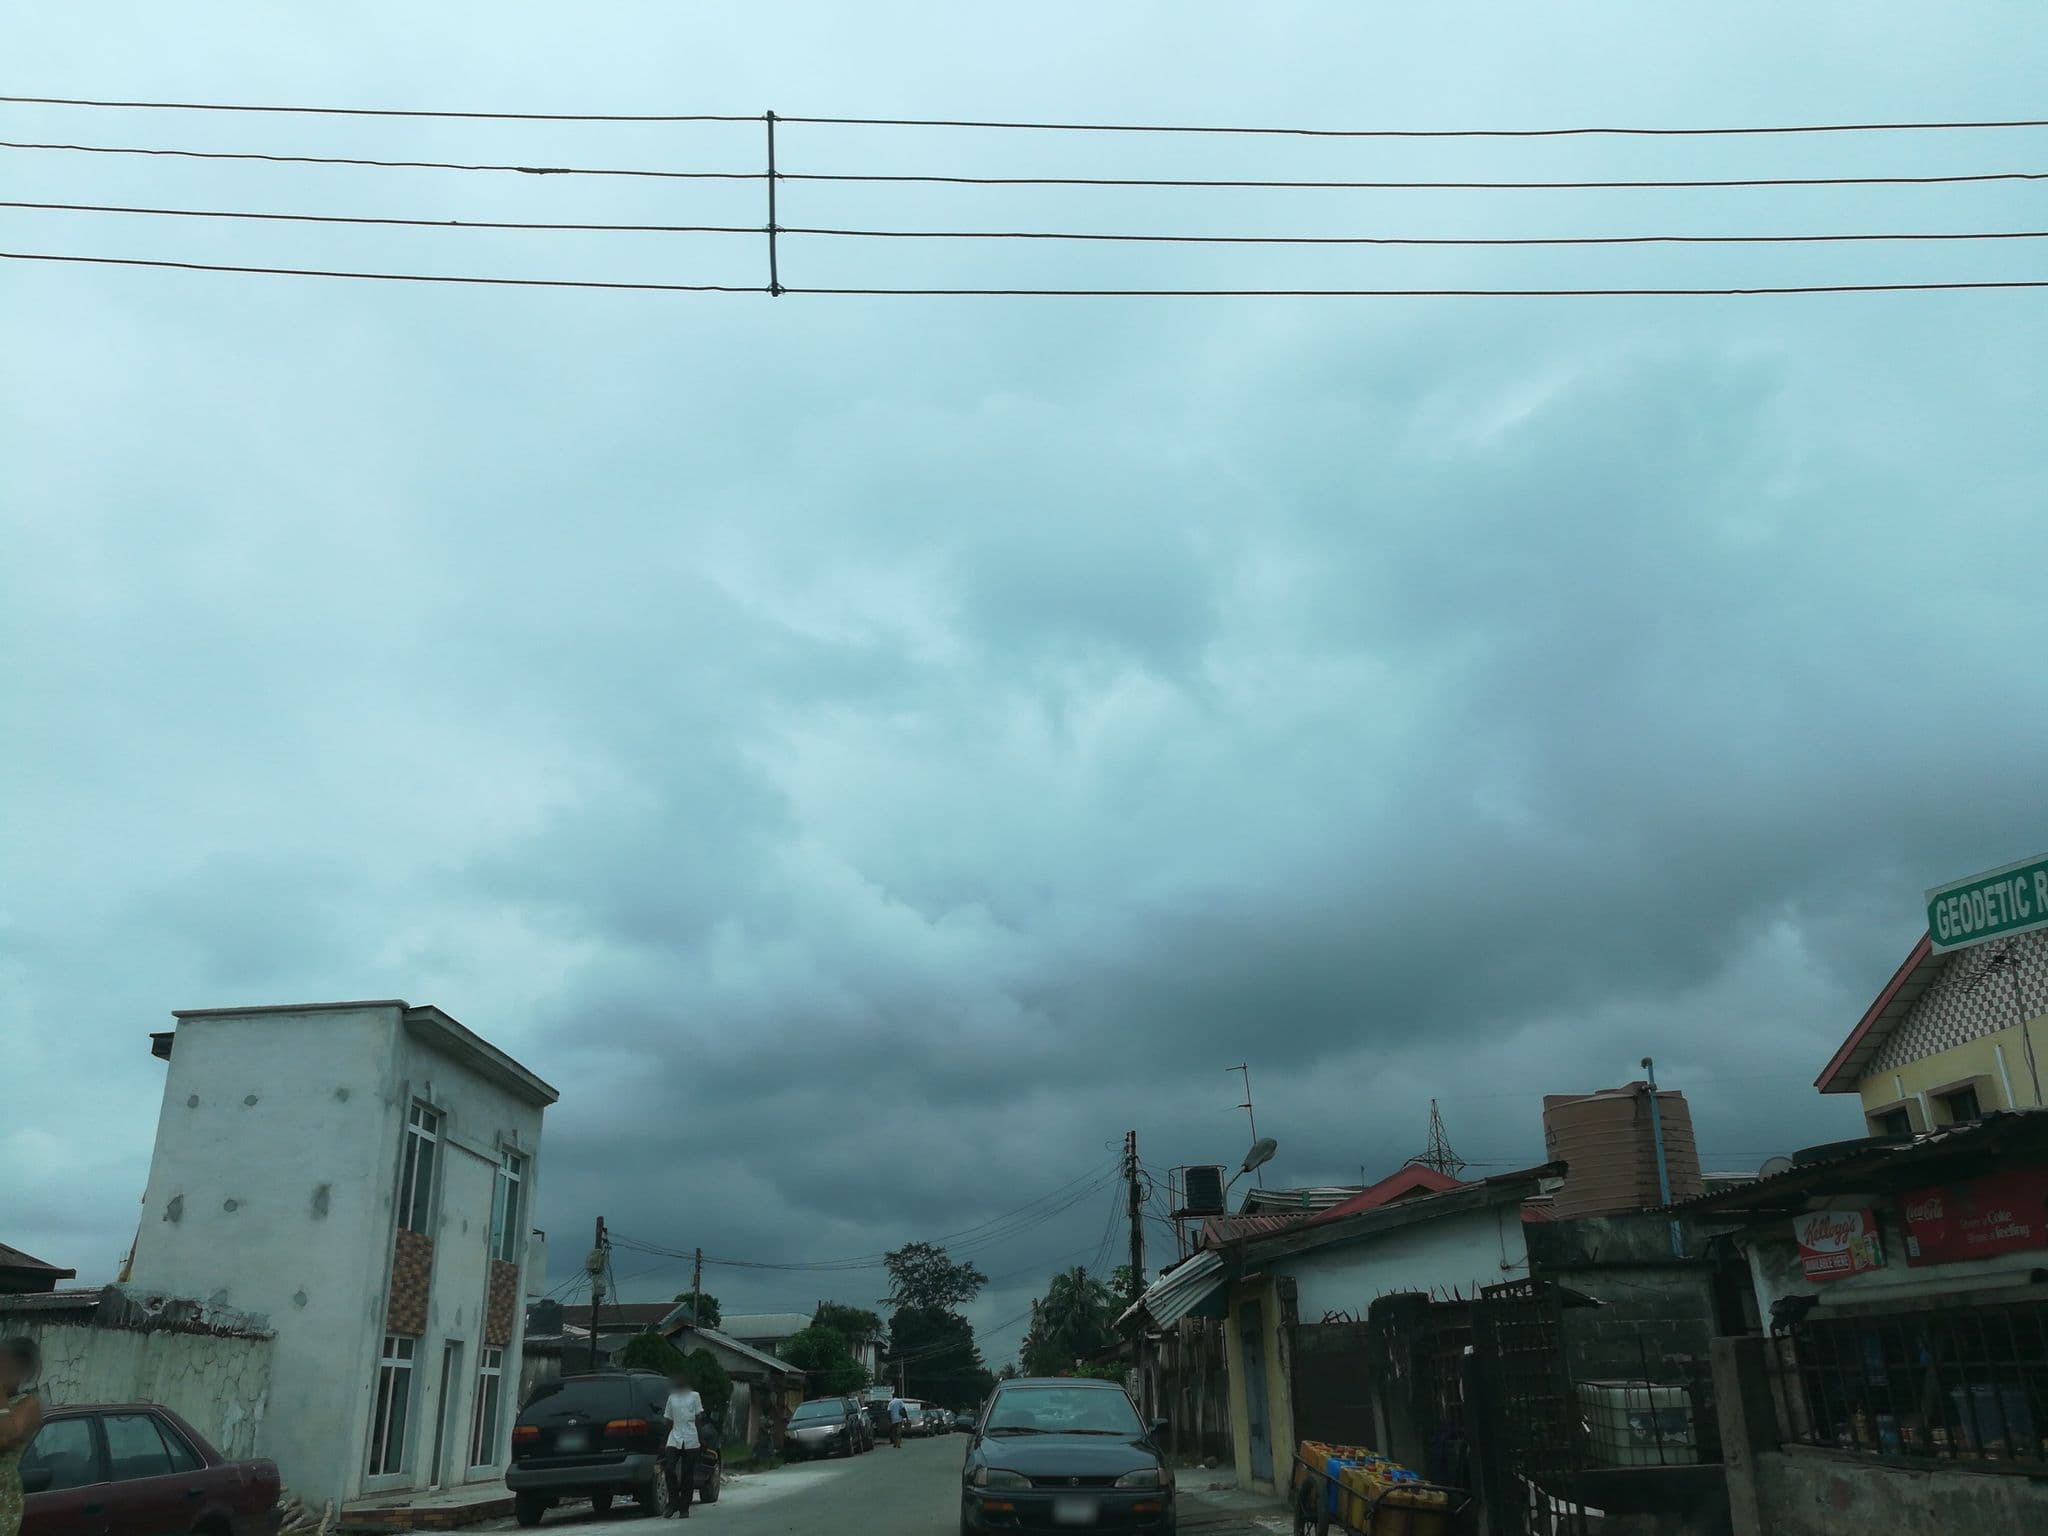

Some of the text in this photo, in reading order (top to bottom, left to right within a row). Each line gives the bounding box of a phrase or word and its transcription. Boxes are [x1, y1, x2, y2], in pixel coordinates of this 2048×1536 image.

[1936, 876, 2031, 940] GEODETIC
[1804, 1215, 1855, 1246] Kellogg's
[1987, 1210, 2012, 1224] Coke
